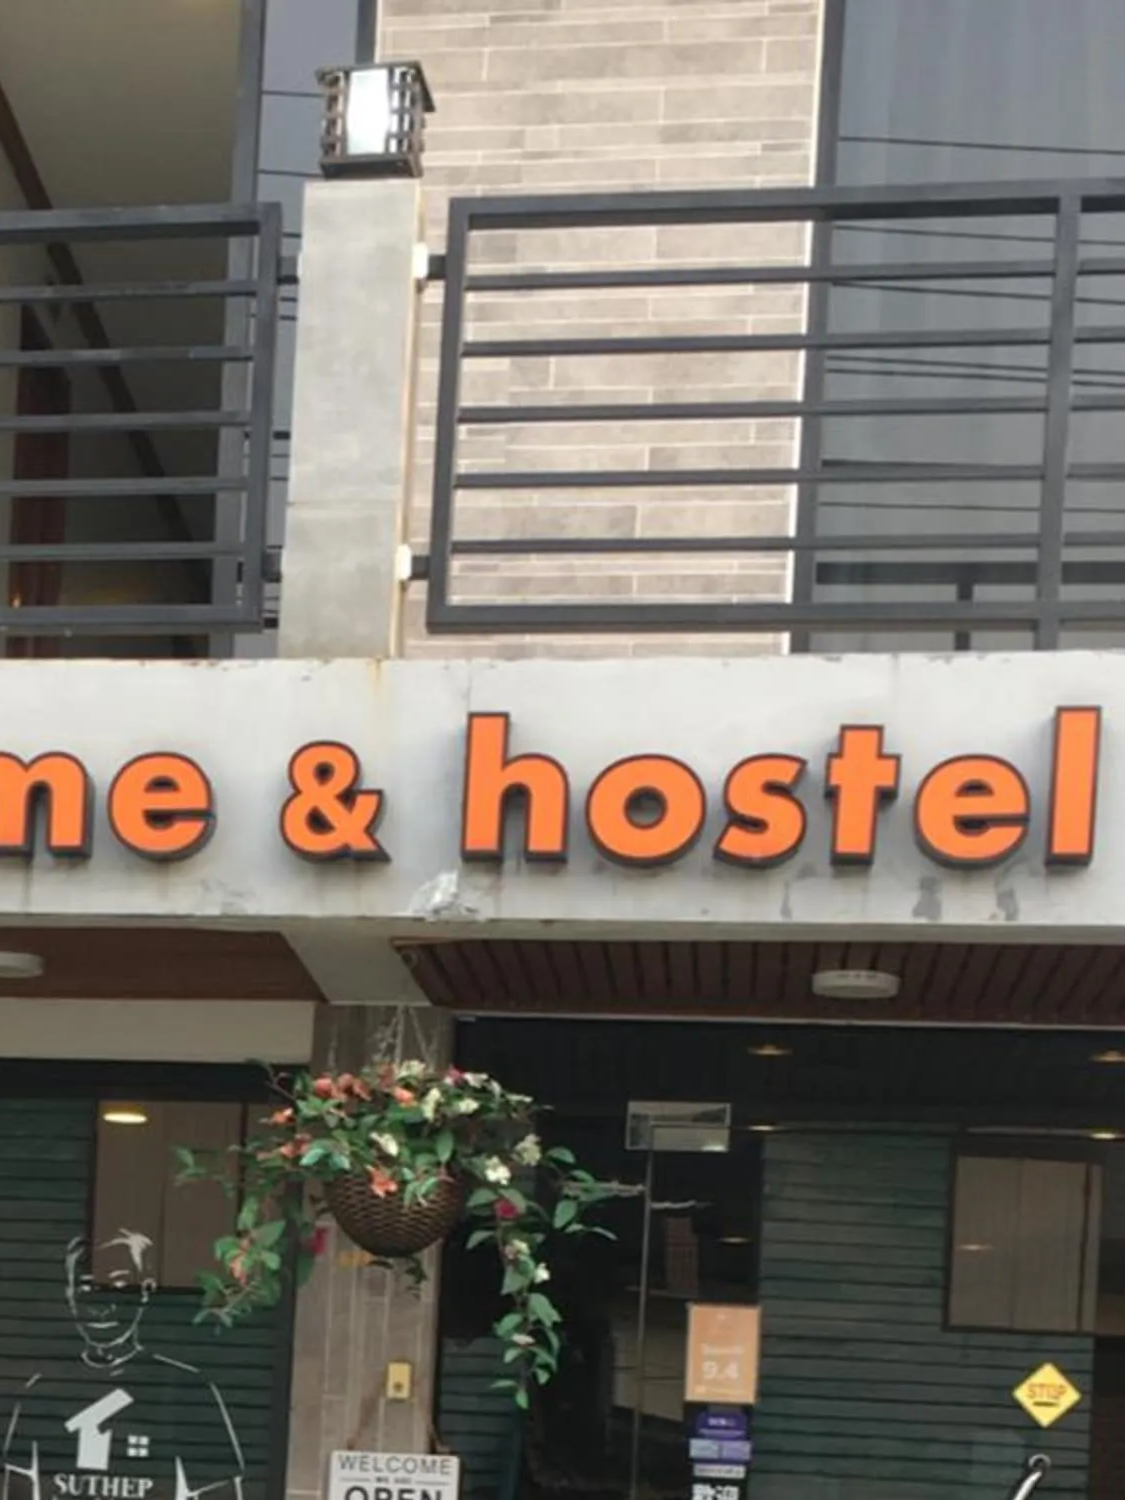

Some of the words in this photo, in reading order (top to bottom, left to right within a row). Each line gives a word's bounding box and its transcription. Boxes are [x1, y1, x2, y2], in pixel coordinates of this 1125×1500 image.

[279, 740, 390, 864] &
[461, 706, 1102, 868] hostel
[338, 1454, 452, 1476] WELCOME
[54, 1473, 154, 1498] SUTHEP
